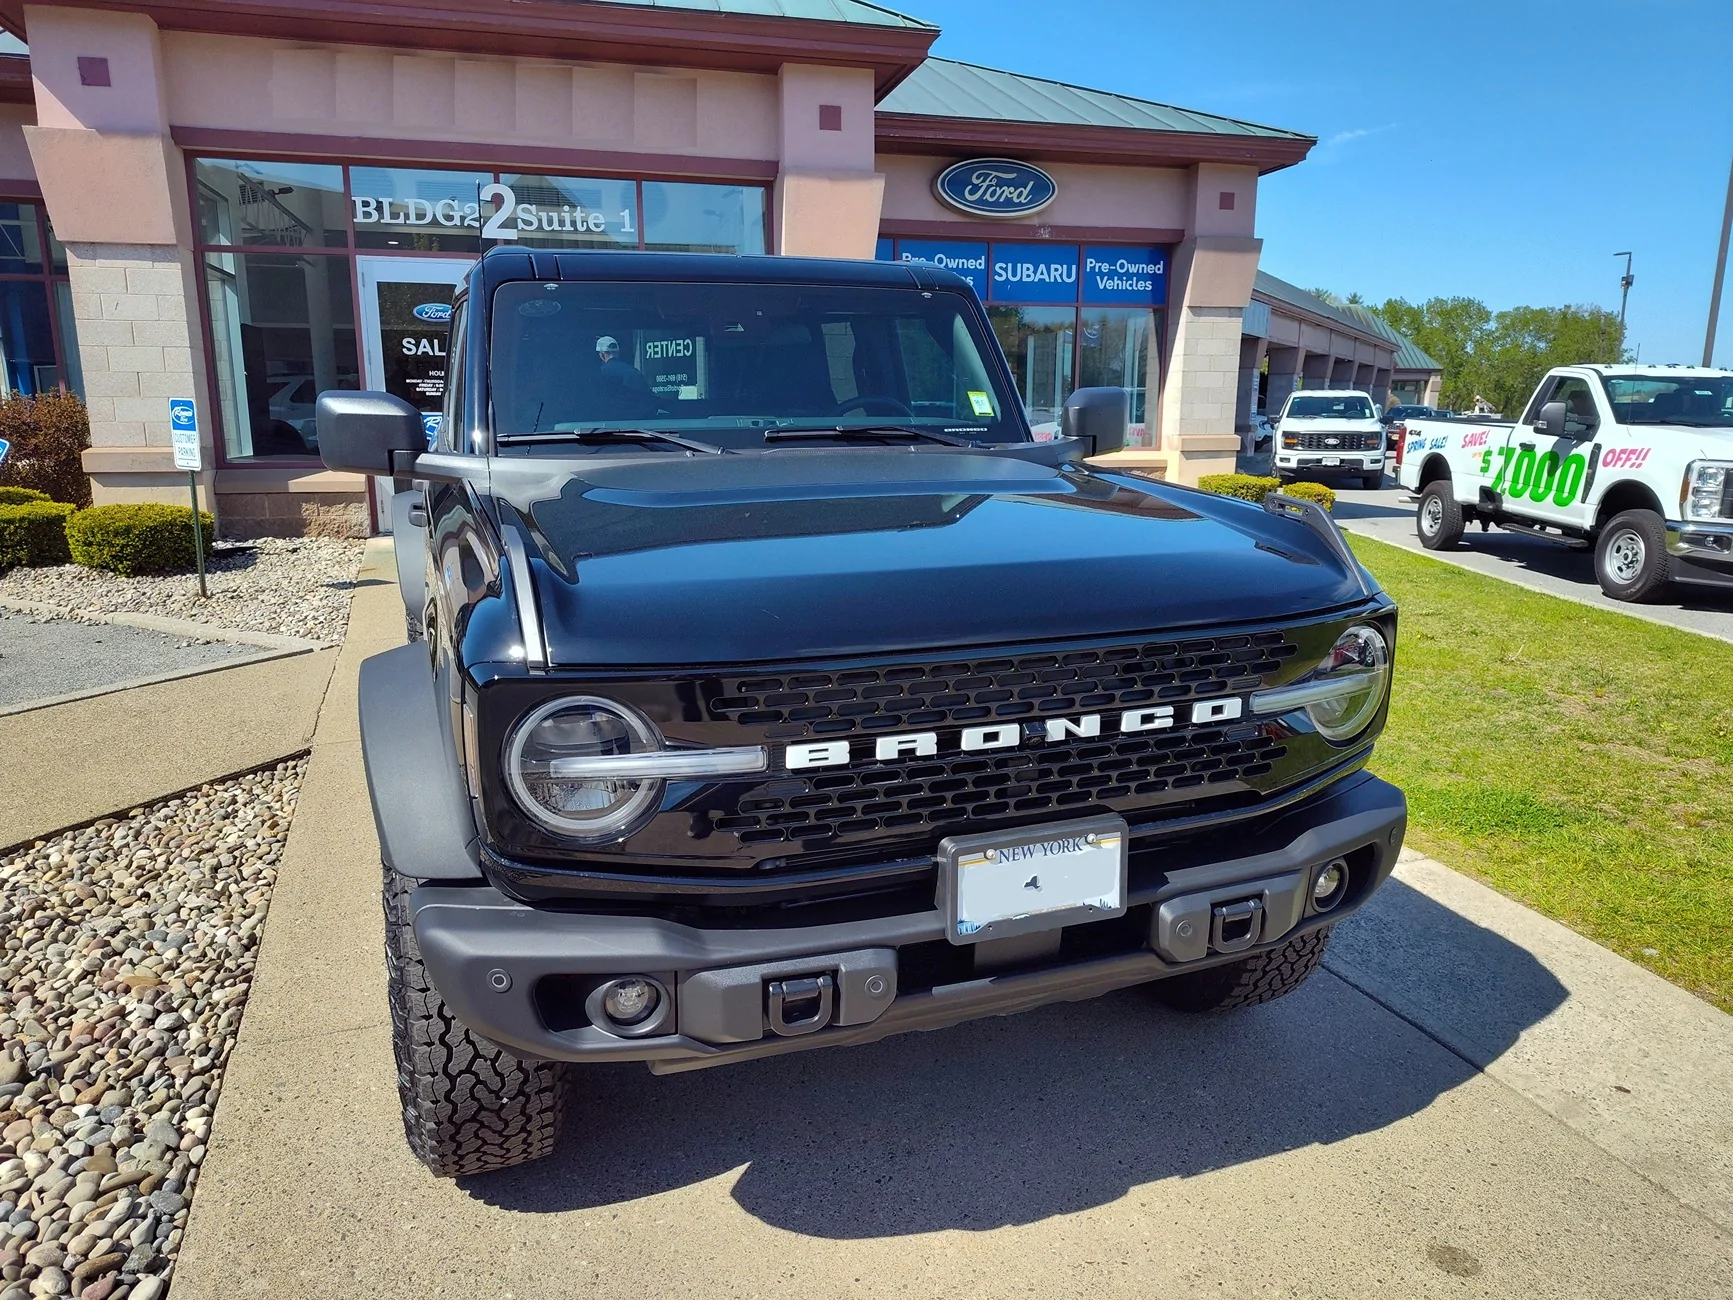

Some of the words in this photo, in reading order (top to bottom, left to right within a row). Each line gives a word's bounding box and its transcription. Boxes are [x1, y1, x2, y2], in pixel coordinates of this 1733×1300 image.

[964, 169, 1035, 204] Ford
[516, 203, 605, 232] Suite
[619, 209, 635, 233] 1
[993, 262, 1077, 283] SUBARU
[1086, 258, 1164, 274] Pre-Owned
[1096, 275, 1153, 291] Vehicles
[422, 305, 451, 319] Ford
[402, 337, 447, 356] SAL
[1461, 429, 1490, 448] SAVE!
[1602, 447, 1652, 469] OFF!!
[784, 696, 1242, 770] BRONCO
[998, 844, 1037, 864] NEW
[1040, 837, 1084, 857] YORK
